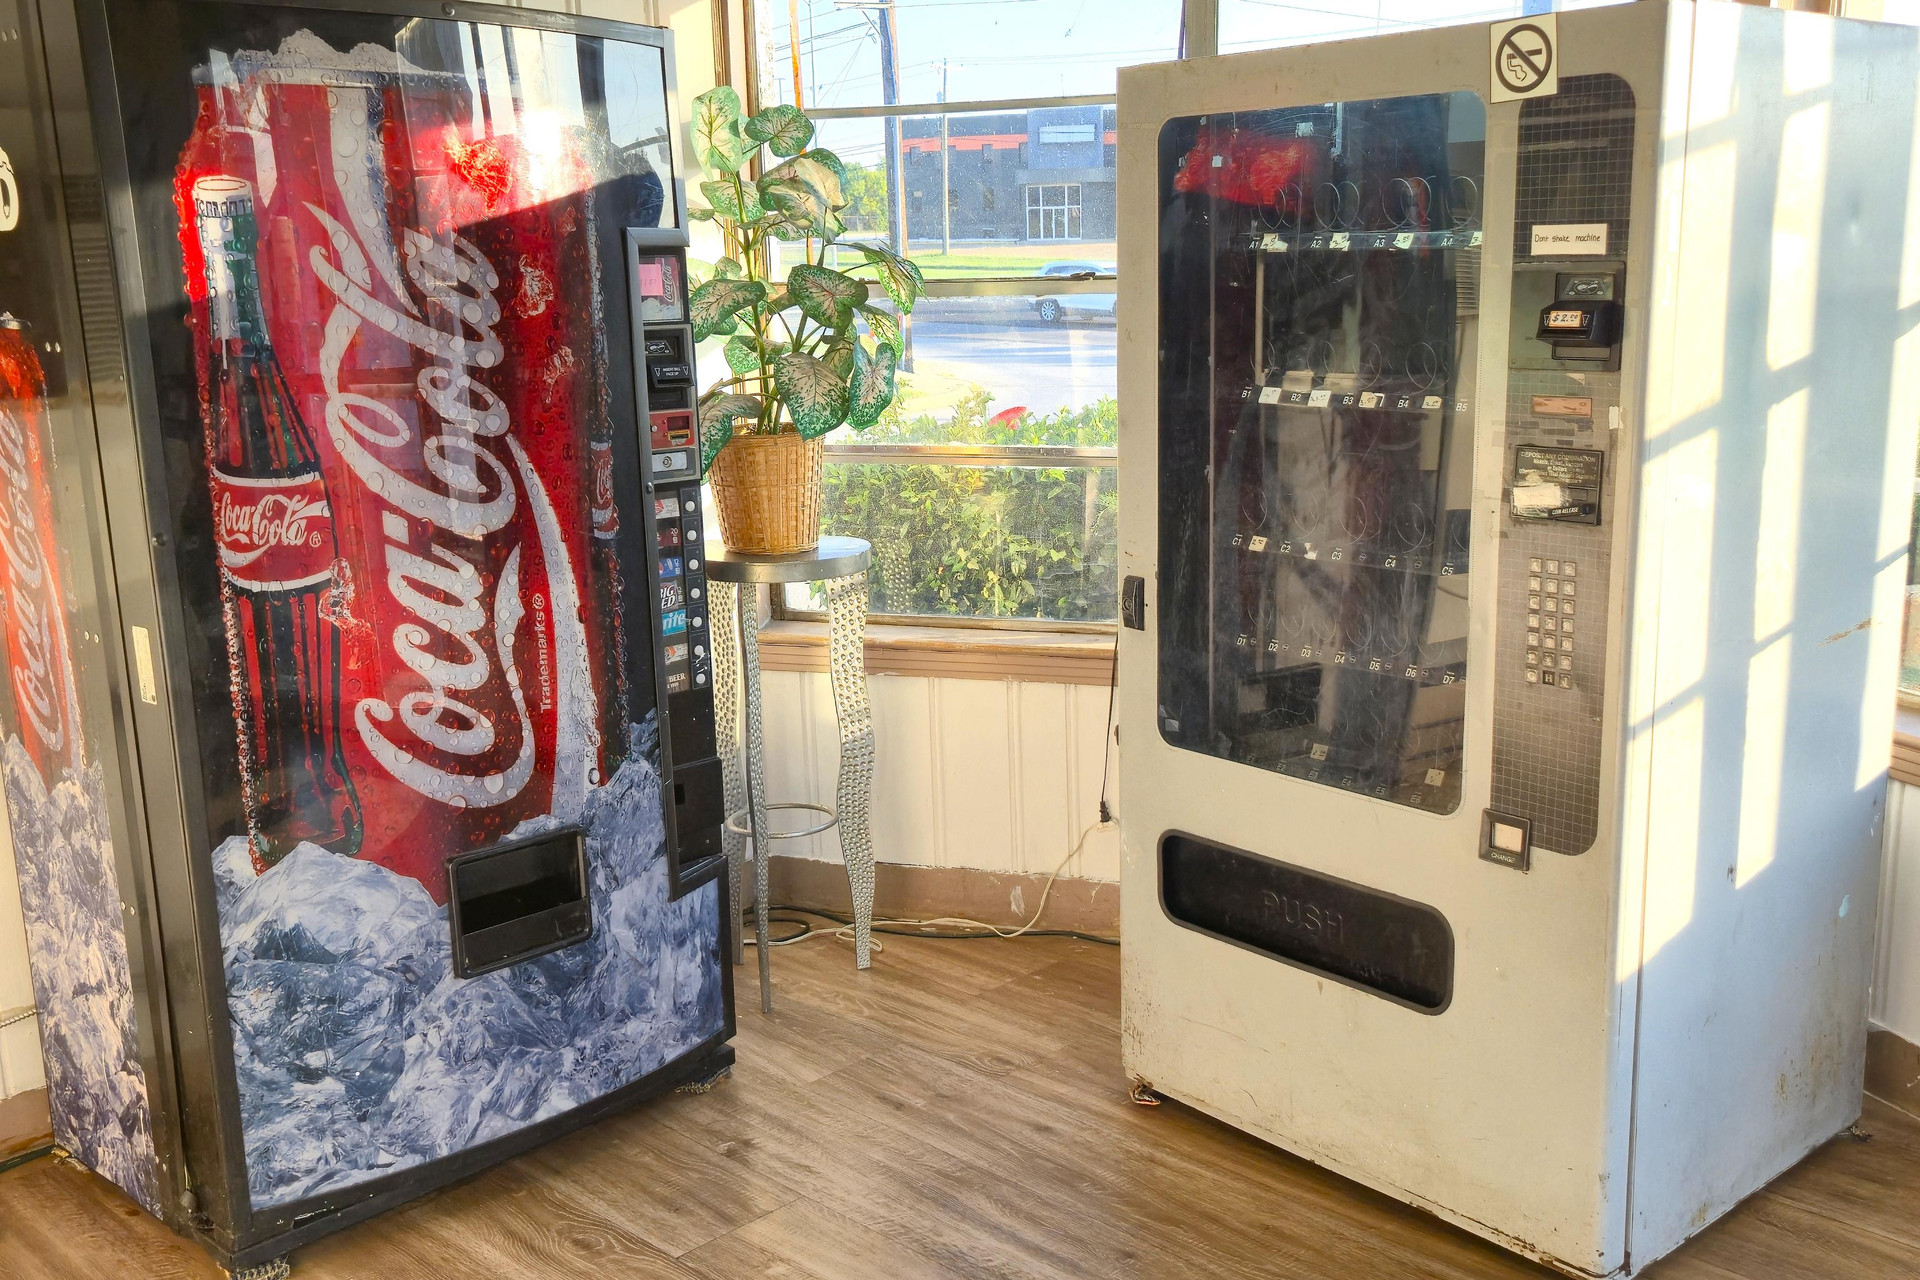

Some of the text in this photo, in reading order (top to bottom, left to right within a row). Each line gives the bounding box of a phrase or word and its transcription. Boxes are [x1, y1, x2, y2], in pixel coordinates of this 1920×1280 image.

[1248, 241, 1259, 249] A1
[1310, 240, 1322, 248] A2
[1372, 239, 1386, 248] A3
[1440, 238, 1454, 247] A4
[1552, 234, 1570, 242] shake
[1575, 232, 1600, 242] machine
[1241, 390, 1252, 398] B1
[1290, 393, 1302, 402] B2
[1342, 396, 1354, 405] B3
[1397, 400, 1409, 408] B4
[1455, 402, 1468, 412] B5
[302, 201, 536, 809] Coca-Cola
[220, 491, 309, 546] Coca-Cola
[1232, 537, 1242, 546] C1
[1280, 544, 1291, 553] C2
[1331, 552, 1342, 560] C3
[1384, 558, 1396, 568] C4
[1441, 566, 1454, 576] C5
[1236, 637, 1455, 684] D1 D2 D3 D4 D5 D6 D7
[668, 672, 686, 683] BEER
[1376, 786, 1386, 796] E5
[1410, 794, 1422, 804] E6
[1491, 852, 1516, 864] CHANGE
[1262, 889, 1344, 945] PUSH
